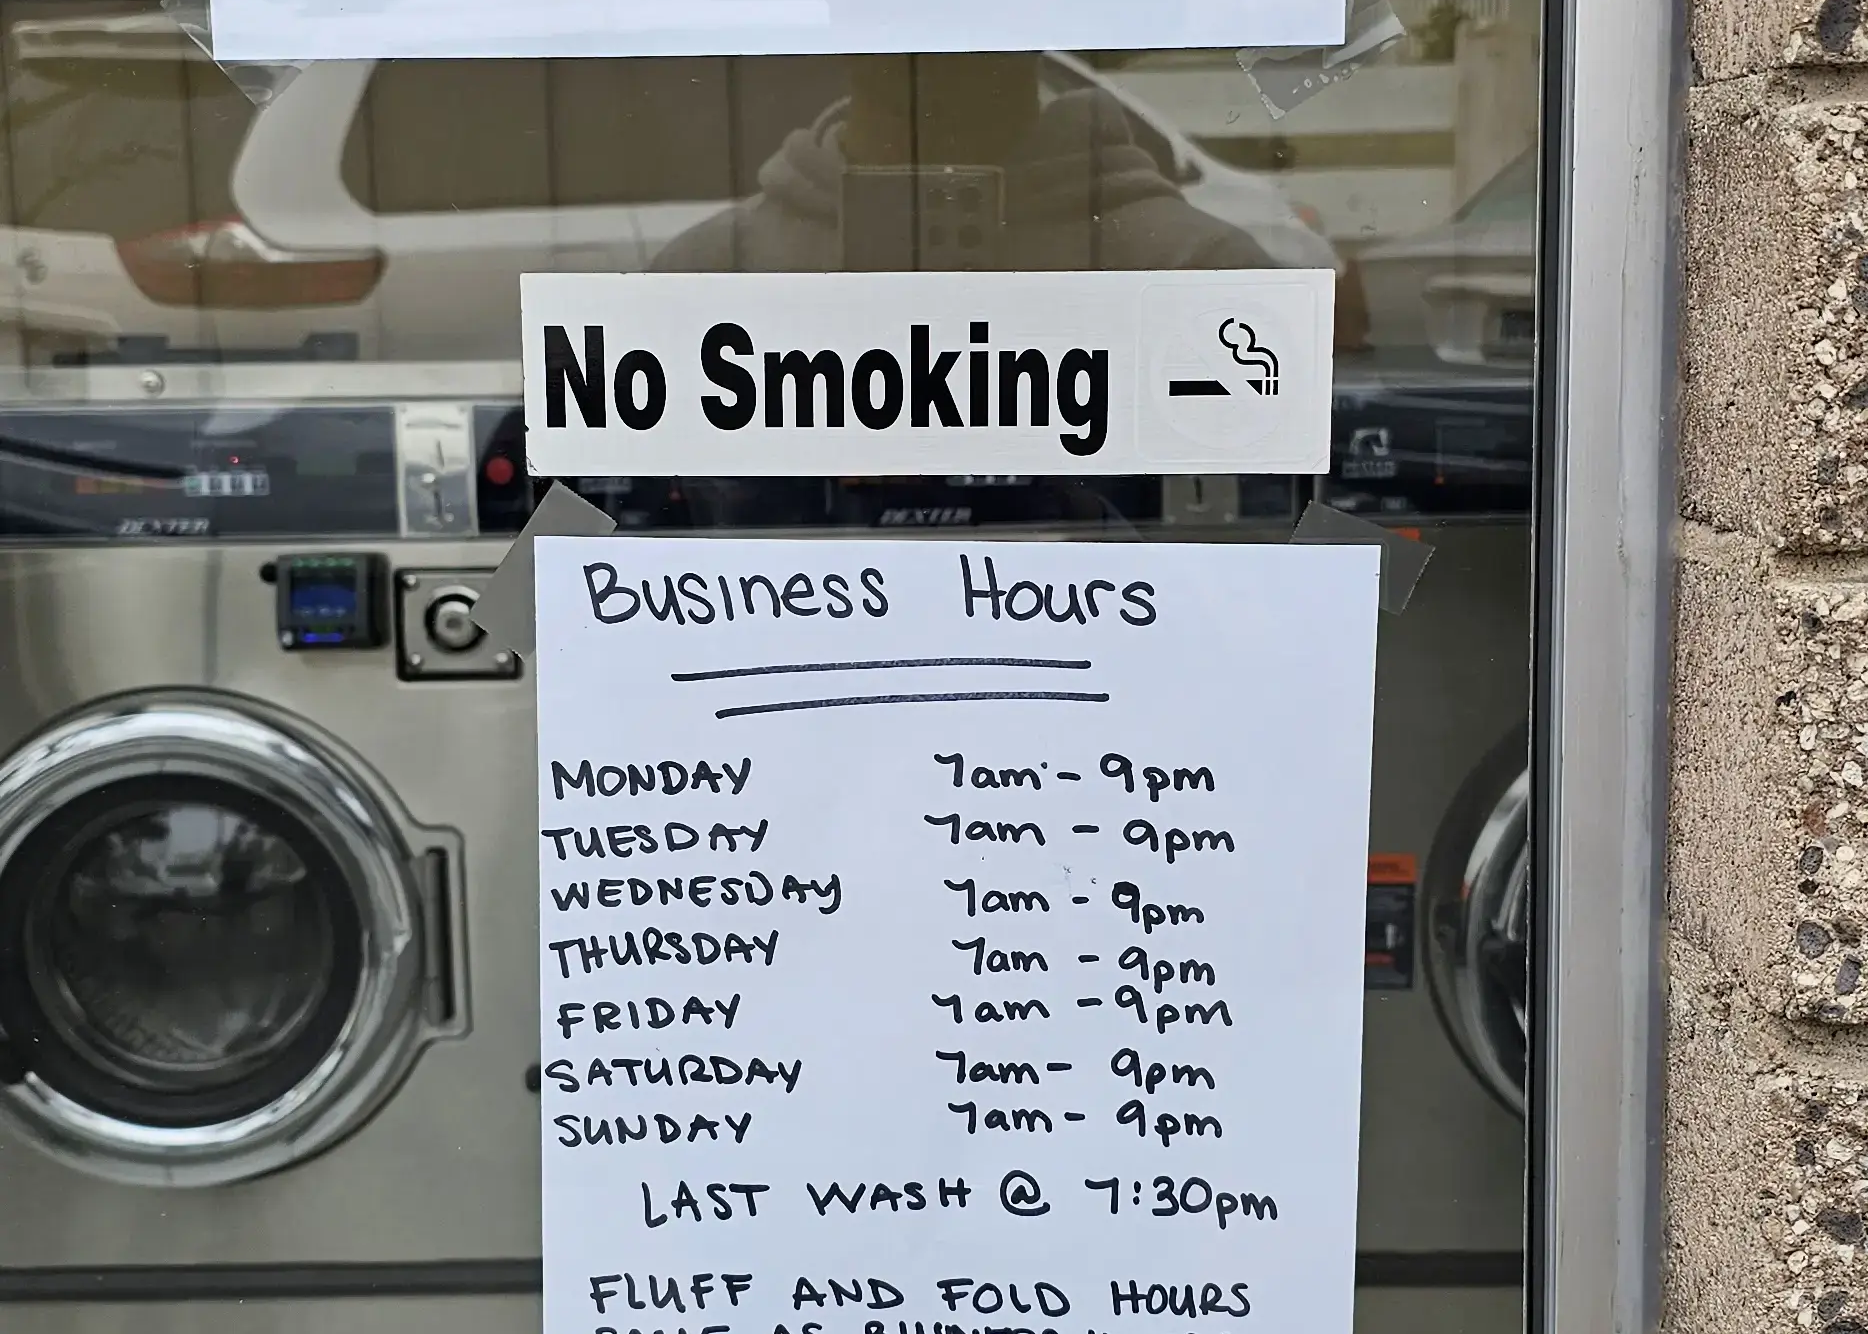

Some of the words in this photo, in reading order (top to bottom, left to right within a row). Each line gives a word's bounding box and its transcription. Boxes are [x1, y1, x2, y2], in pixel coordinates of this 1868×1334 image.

[543, 323, 667, 431] No
[700, 322, 1109, 457] Smoking
[582, 562, 889, 626] Business
[959, 556, 1157, 627] Hours
[550, 757, 752, 801] MONDAY
[1099, 752, 1216, 803] 9pm
[544, 818, 769, 861] TUESDAY
[1122, 818, 1235, 865] 9pm
[550, 870, 842, 916] WEDNESDAY
[1111, 881, 1205, 935] 9pm
[548, 929, 780, 979] THURSDAY
[1118, 945, 1216, 995] 9pm
[556, 993, 741, 1040] FRIDAY
[544, 1054, 803, 1094] SATURDAY
[1110, 1047, 1216, 1095] 9pm
[553, 1111, 752, 1148] SUNDAY
[1115, 1099, 1223, 1148] 9pm
[641, 1180, 771, 1229] LAST
[806, 1177, 973, 1217] WASH
[999, 1169, 1051, 1217] @
[1084, 1176, 1278, 1231] 7:30pm
[589, 1272, 753, 1315] FLUFF
[792, 1276, 905, 1311] AND
[936, 1277, 1071, 1318] FOLD
[1110, 1279, 1251, 1318] HOURS
